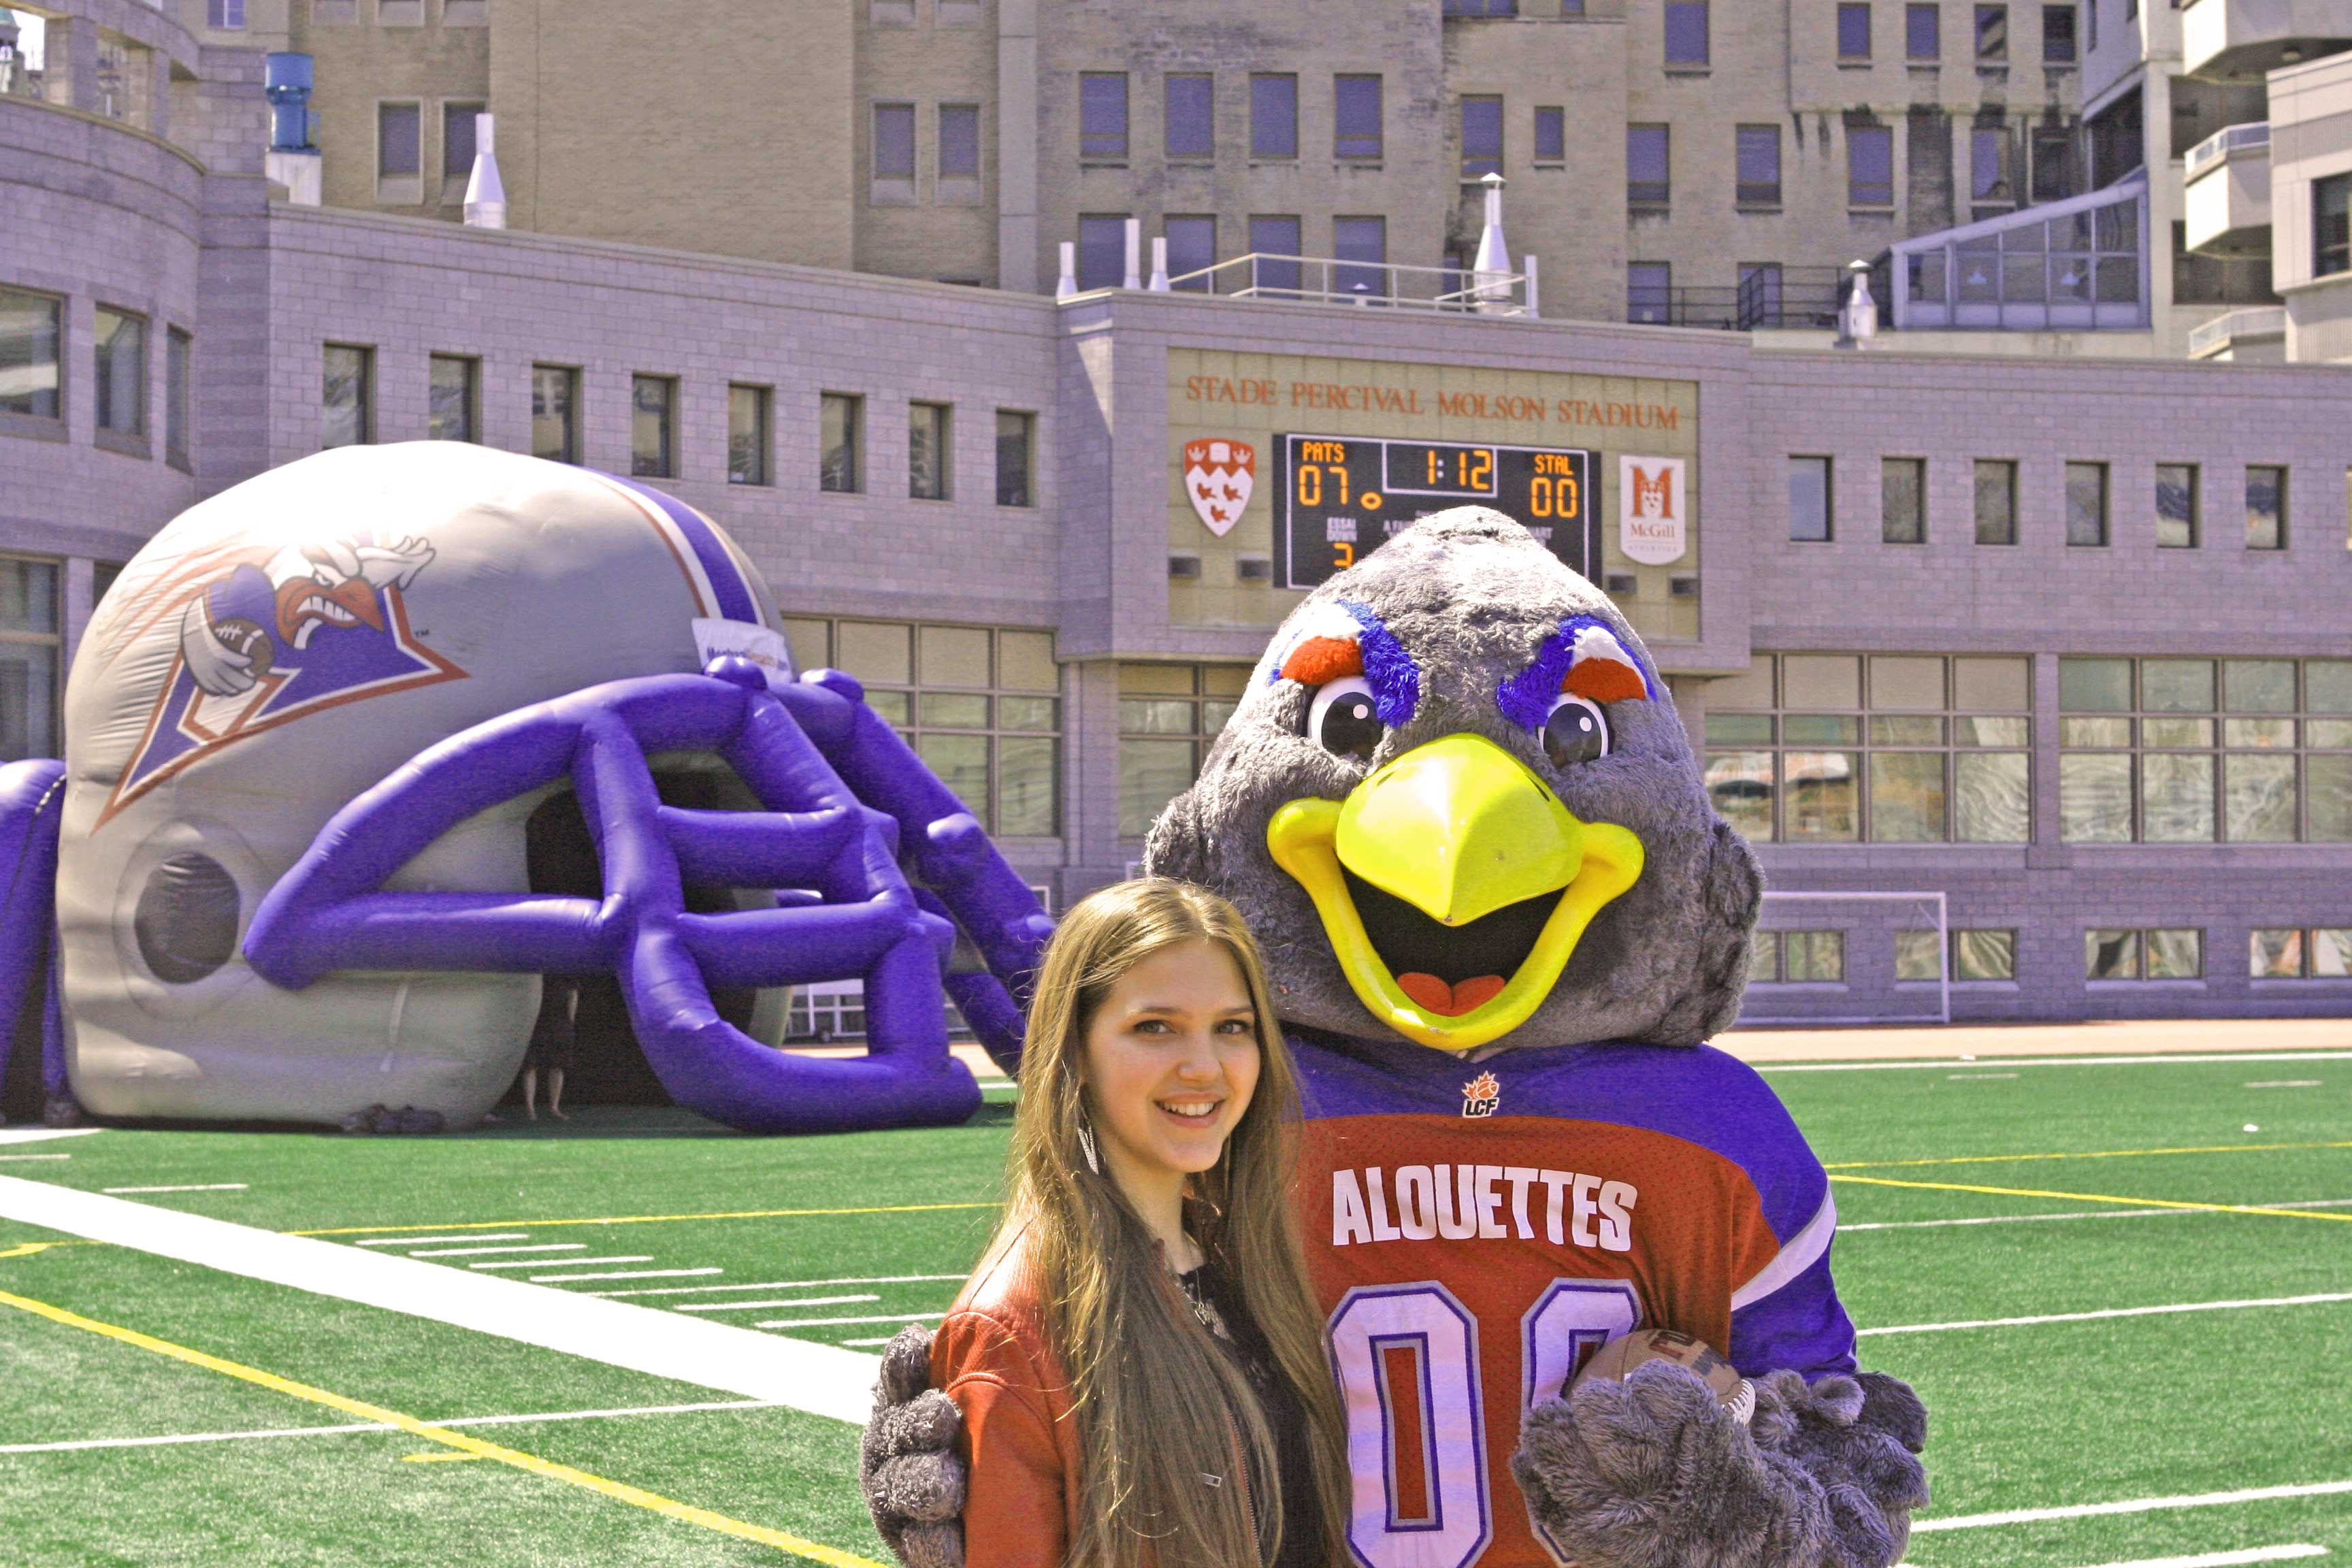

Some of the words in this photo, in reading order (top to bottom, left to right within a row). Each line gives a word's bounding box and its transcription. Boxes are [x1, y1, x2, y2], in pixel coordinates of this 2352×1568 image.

[1187, 376, 1278, 406] STADE
[1291, 382, 1424, 414] PERCIVAL
[1438, 391, 1546, 422] MOLSON
[1557, 399, 1679, 430] STADIUM
[1303, 442, 1345, 463] PATS
[1427, 449, 1492, 490] 1:12
[1534, 454, 1574, 475] STAL
[1298, 464, 1349, 506] 07
[1531, 477, 1578, 518] 00
[1630, 523, 1675, 538] McGill
[1465, 1098, 1498, 1115] LCF
[1332, 1164, 1638, 1252] ALOUETTES
